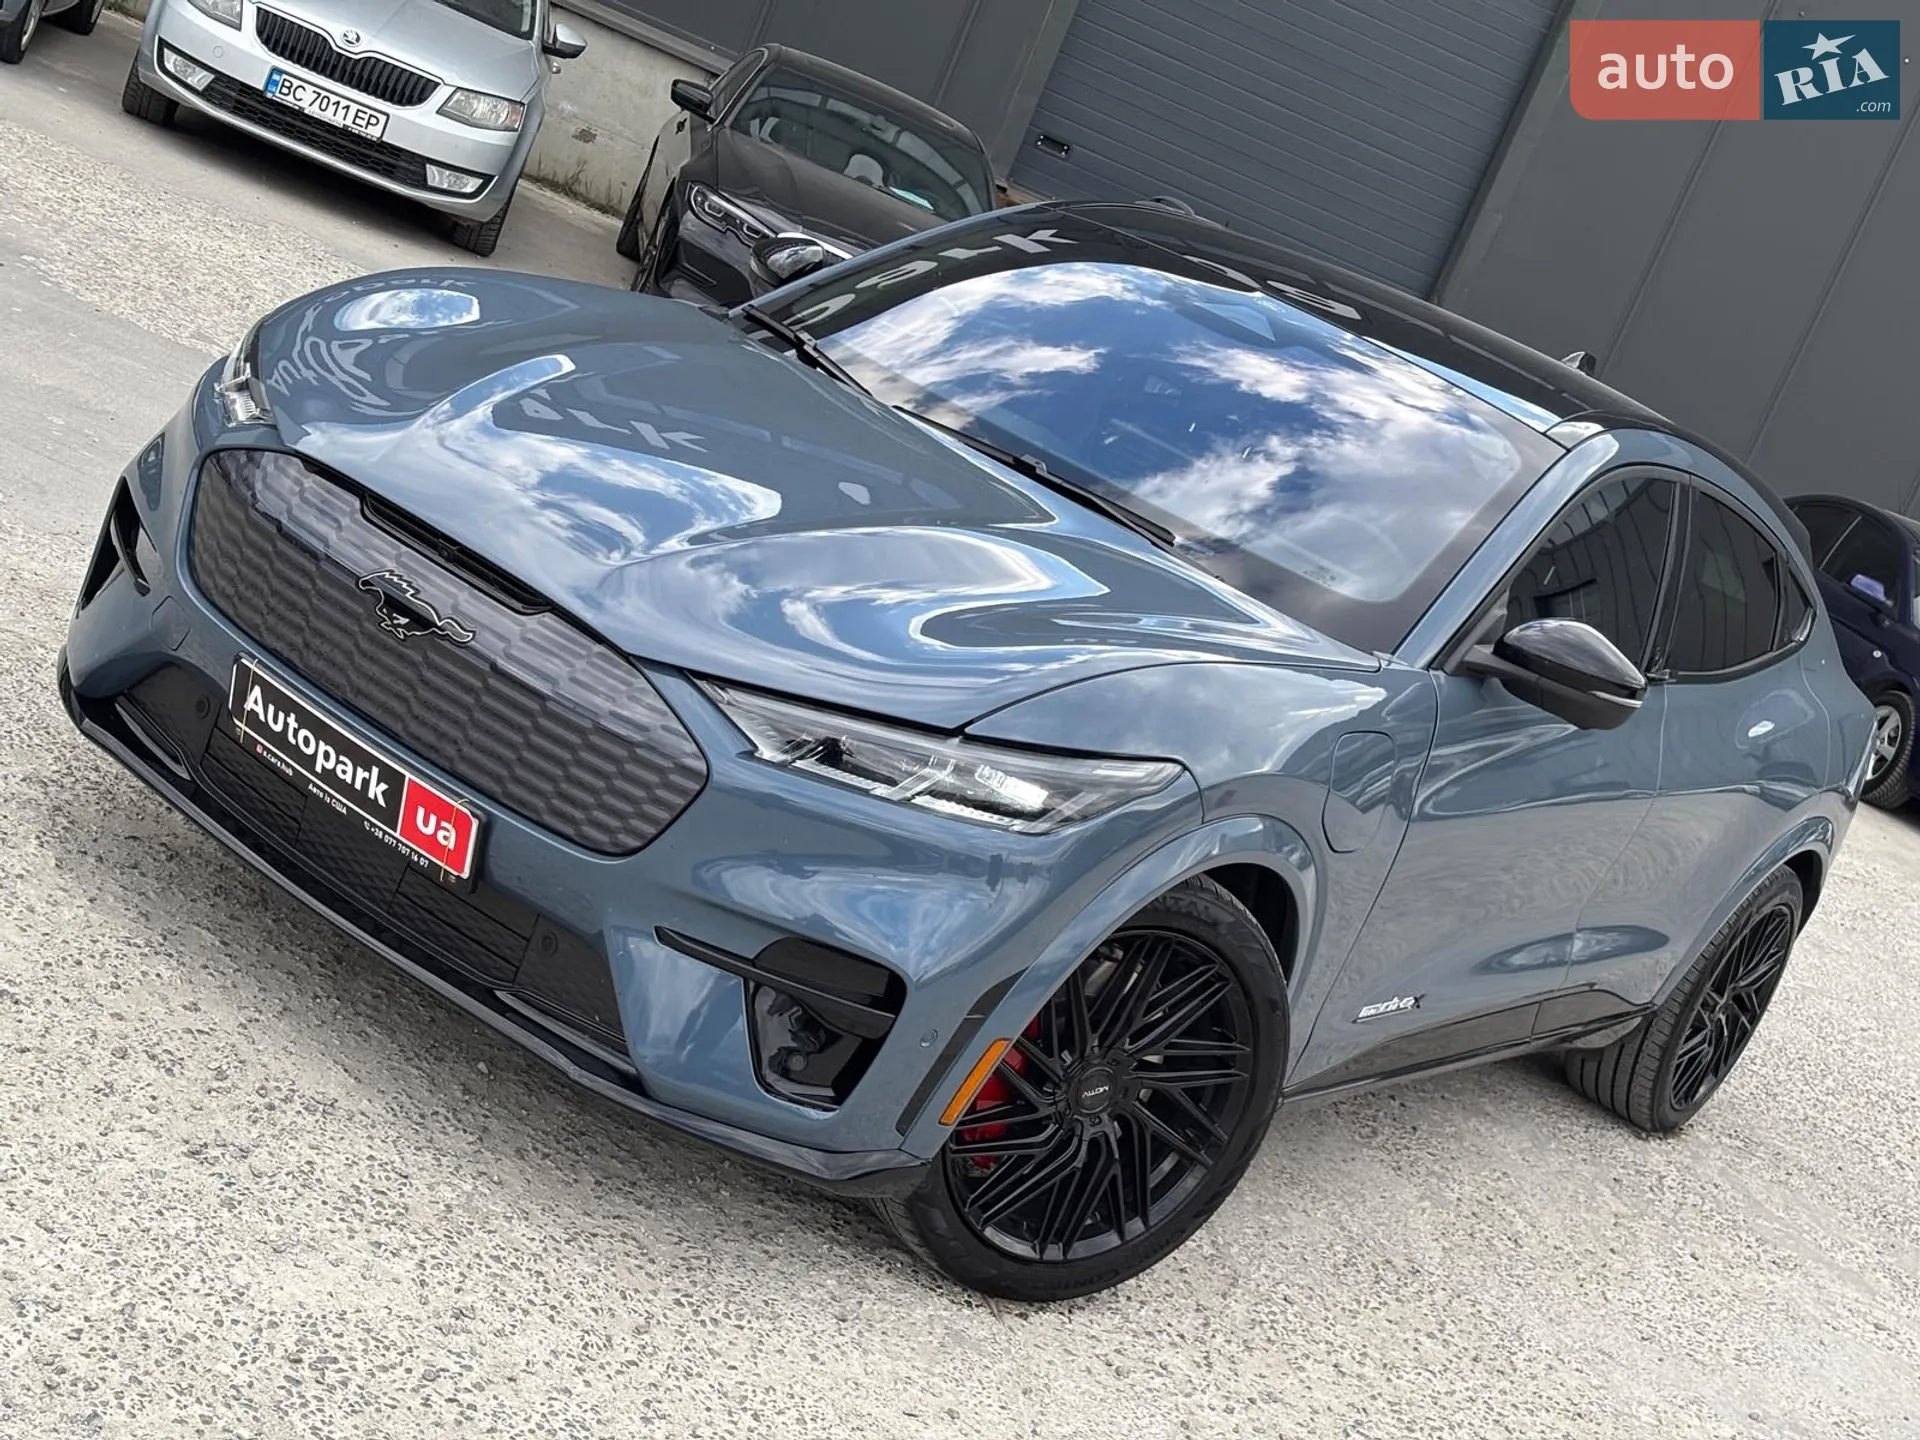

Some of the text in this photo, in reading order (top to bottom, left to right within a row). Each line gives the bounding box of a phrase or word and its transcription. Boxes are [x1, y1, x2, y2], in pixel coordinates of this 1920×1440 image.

[278, 78, 306, 102] BC
[308, 90, 351, 121] 7011
[351, 108, 380, 130] EP
[243, 684, 457, 851] Autopark ua
[1082, 1084, 1109, 1099] MOTIV
